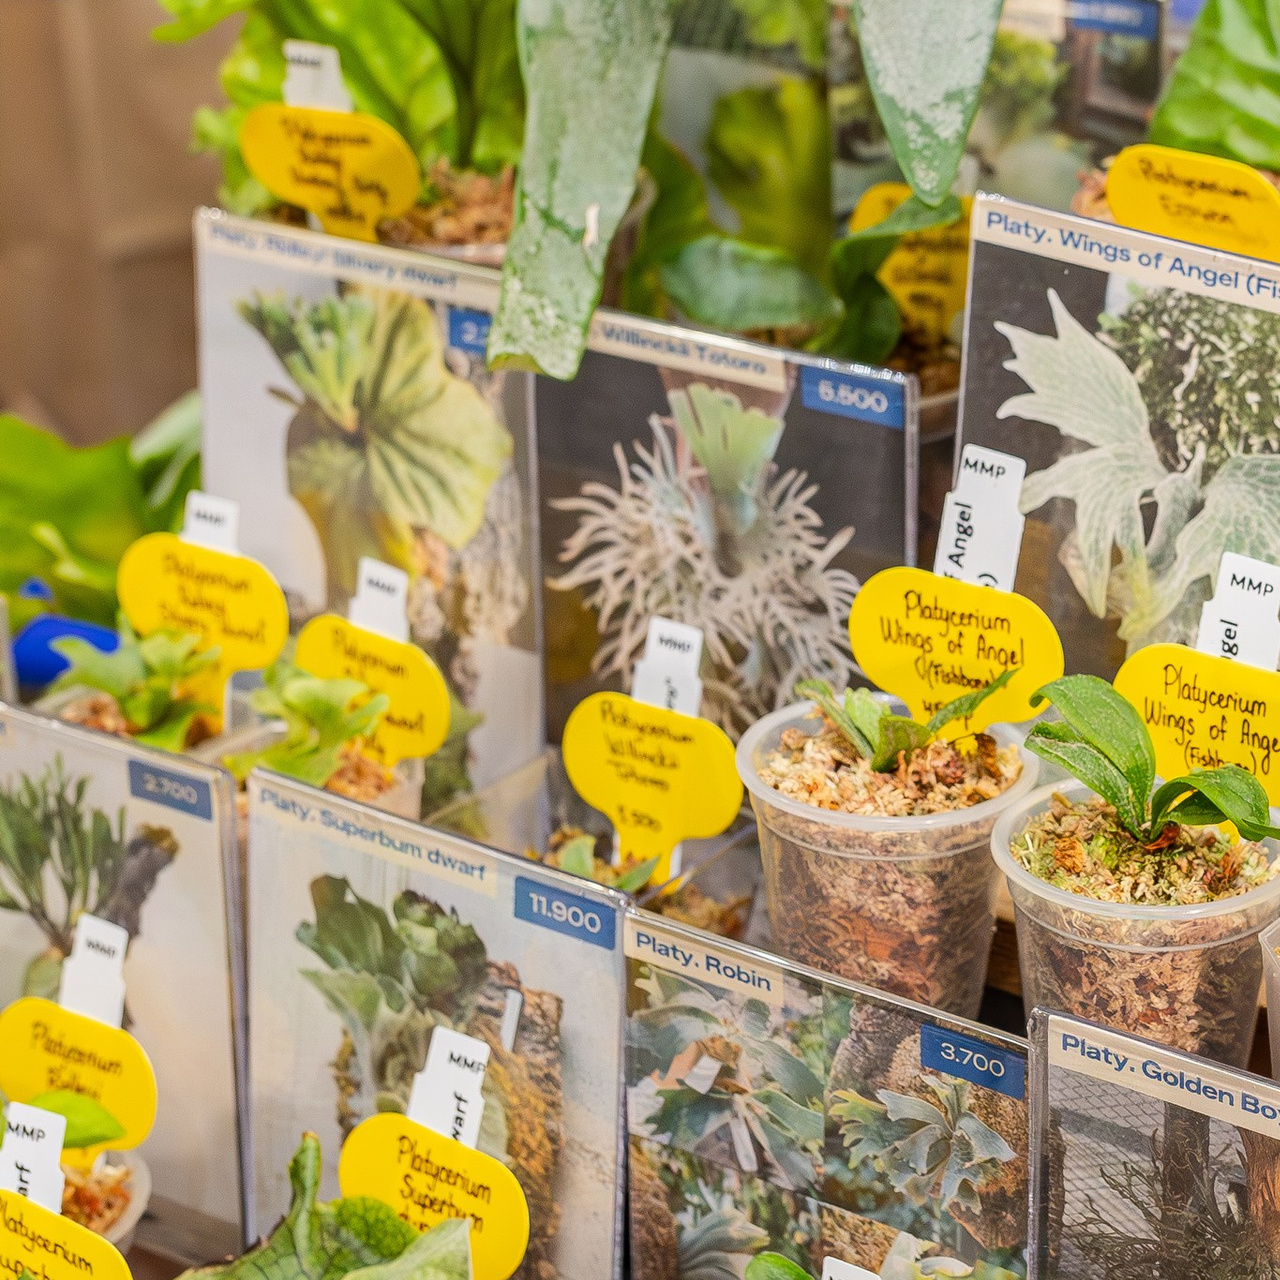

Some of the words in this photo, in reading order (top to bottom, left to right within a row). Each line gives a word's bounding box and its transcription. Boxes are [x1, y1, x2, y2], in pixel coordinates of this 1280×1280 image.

[987, 210, 1054, 245] Platy.
[1060, 228, 1131, 266] Wings
[1137, 252, 1162, 271] of
[1169, 256, 1240, 290] Angel
[964, 456, 1006, 480] MMP
[947, 501, 974, 569] Angel
[1230, 572, 1275, 598] MMP
[904, 589, 1011, 638] Platycerium
[1220, 619, 1239, 660] gel
[880, 616, 934, 678] Wings
[947, 631, 966, 656] of
[977, 634, 1025, 672] Angel
[1163, 662, 1267, 718] Platycerium
[1143, 695, 1196, 747] Wings
[1208, 714, 1228, 742] of
[319, 809, 422, 859] Superbum
[426, 847, 488, 881] dwarf
[528, 890, 602, 934] 11.900
[635, 930, 701, 969] Platy.
[704, 955, 773, 993] Robin
[939, 1041, 1006, 1078] 3.700
[1061, 1032, 1136, 1074] Platy.
[1141, 1059, 1235, 1107] Golden
[7, 1121, 46, 1142] MMP
[451, 1091, 469, 1142] warf
[15, 1161, 32, 1197] arf
[397, 1134, 492, 1205] Platycerium
[0, 1196, 94, 1276] latycerium
